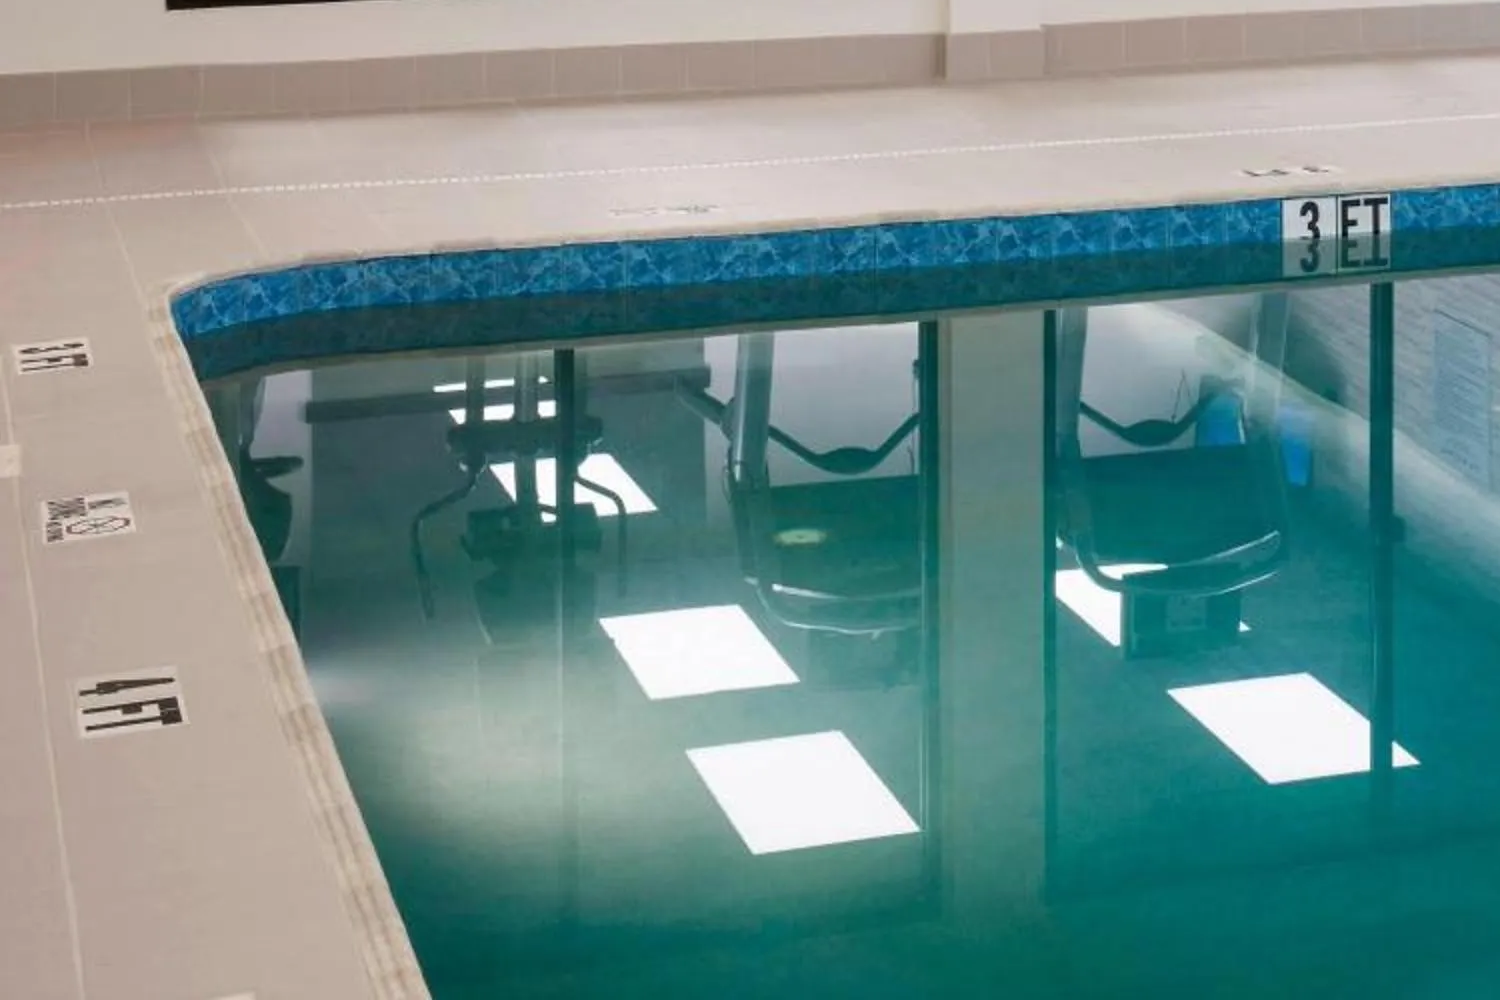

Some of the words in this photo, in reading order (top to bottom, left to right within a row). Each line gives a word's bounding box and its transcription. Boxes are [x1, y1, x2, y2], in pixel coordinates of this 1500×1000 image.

[1300, 201, 1320, 239] 3
[1341, 197, 1388, 237] FT
[82, 696, 182, 732] FT
